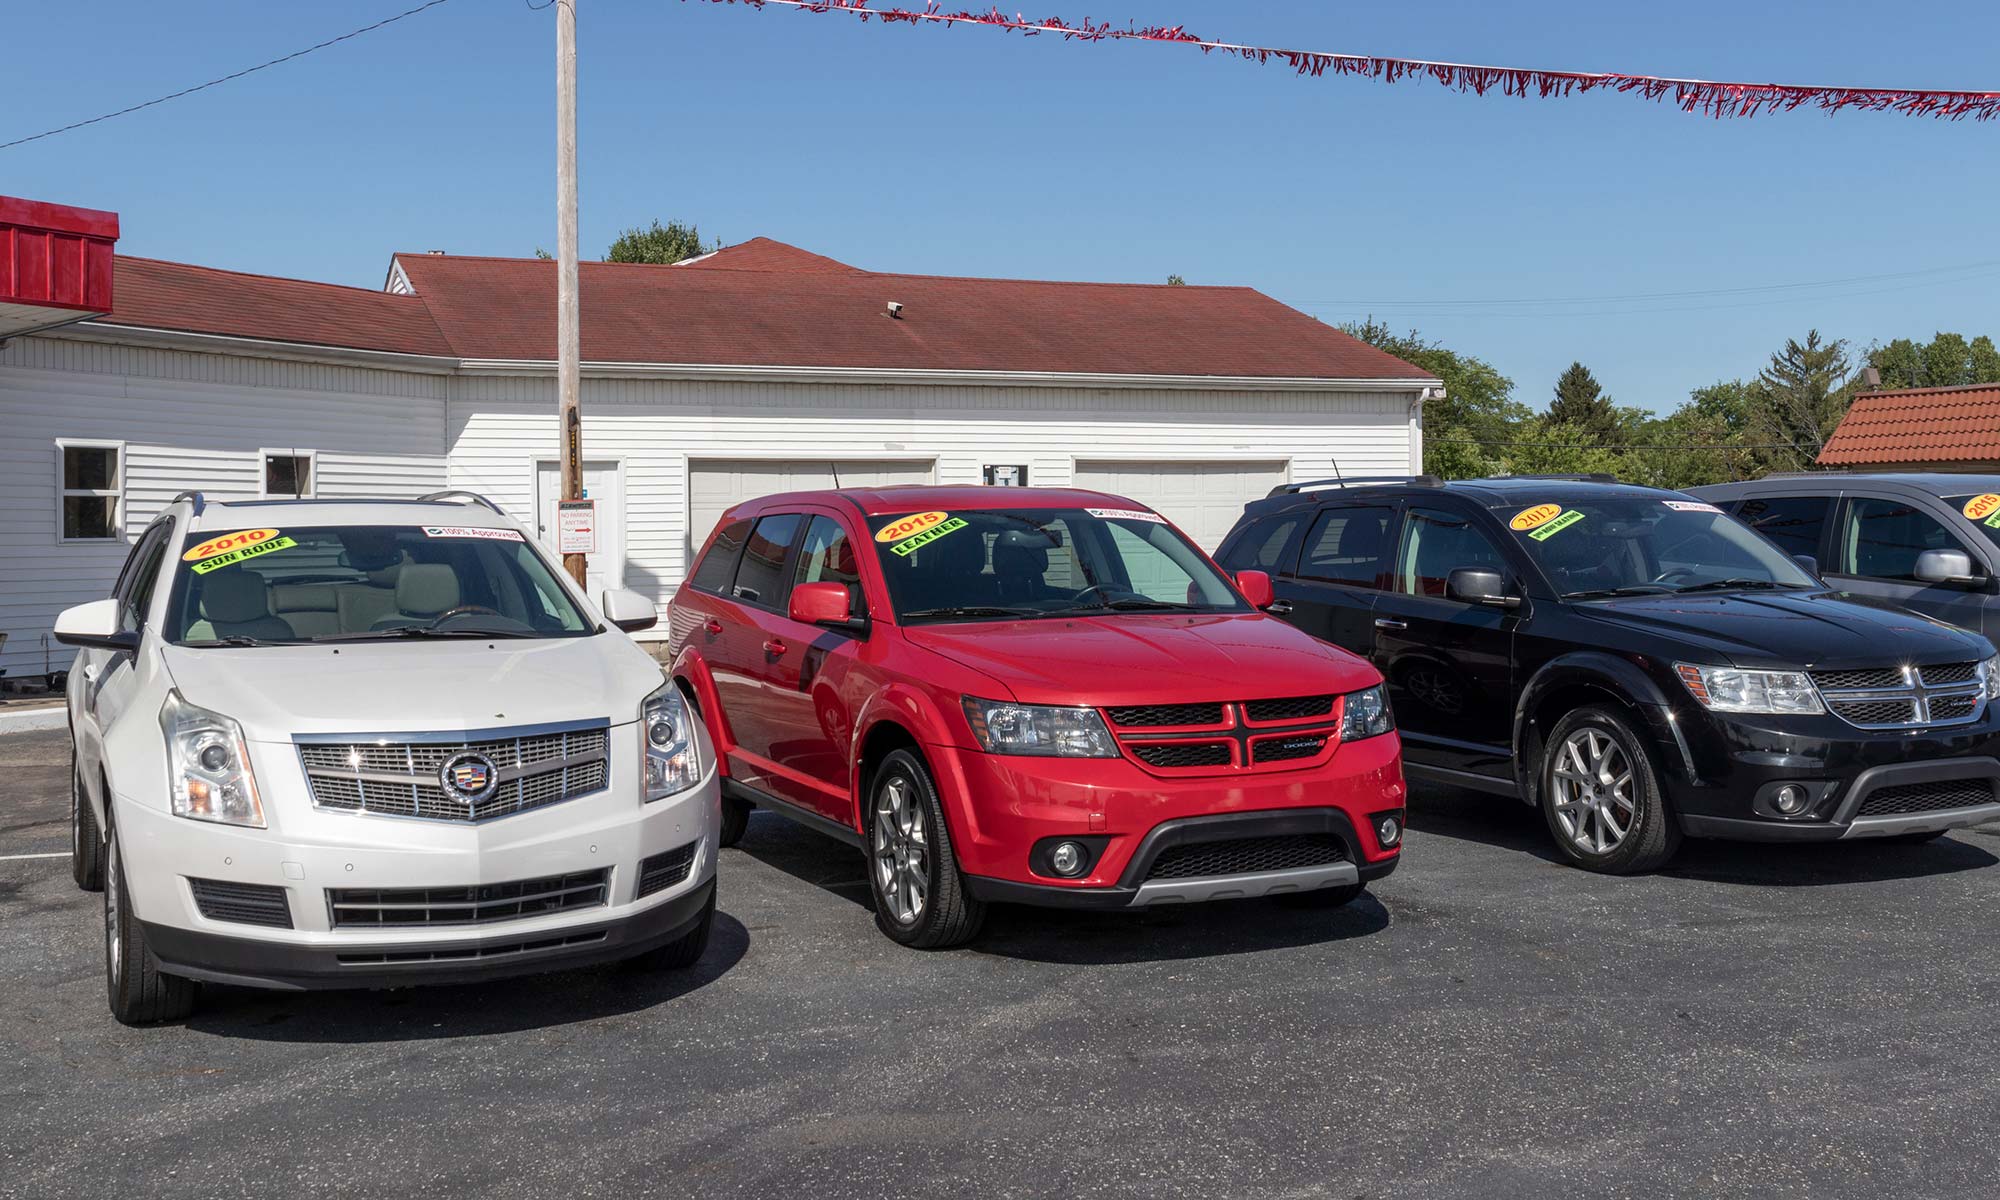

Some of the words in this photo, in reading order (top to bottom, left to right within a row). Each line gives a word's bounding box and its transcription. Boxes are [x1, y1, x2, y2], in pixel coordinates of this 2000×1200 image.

[1518, 506, 1555, 528] 2012
[1968, 495, 1998, 517] 2015
[442, 527, 471, 536] 100%
[471, 529, 521, 540] Approved!
[885, 512, 939, 540] 2015
[895, 518, 962, 554] LEATHER
[198, 530, 266, 557] 2010
[200, 553, 237, 571] SUN
[241, 538, 288, 557] ROOF
[1283, 740, 1318, 749] DODGE
